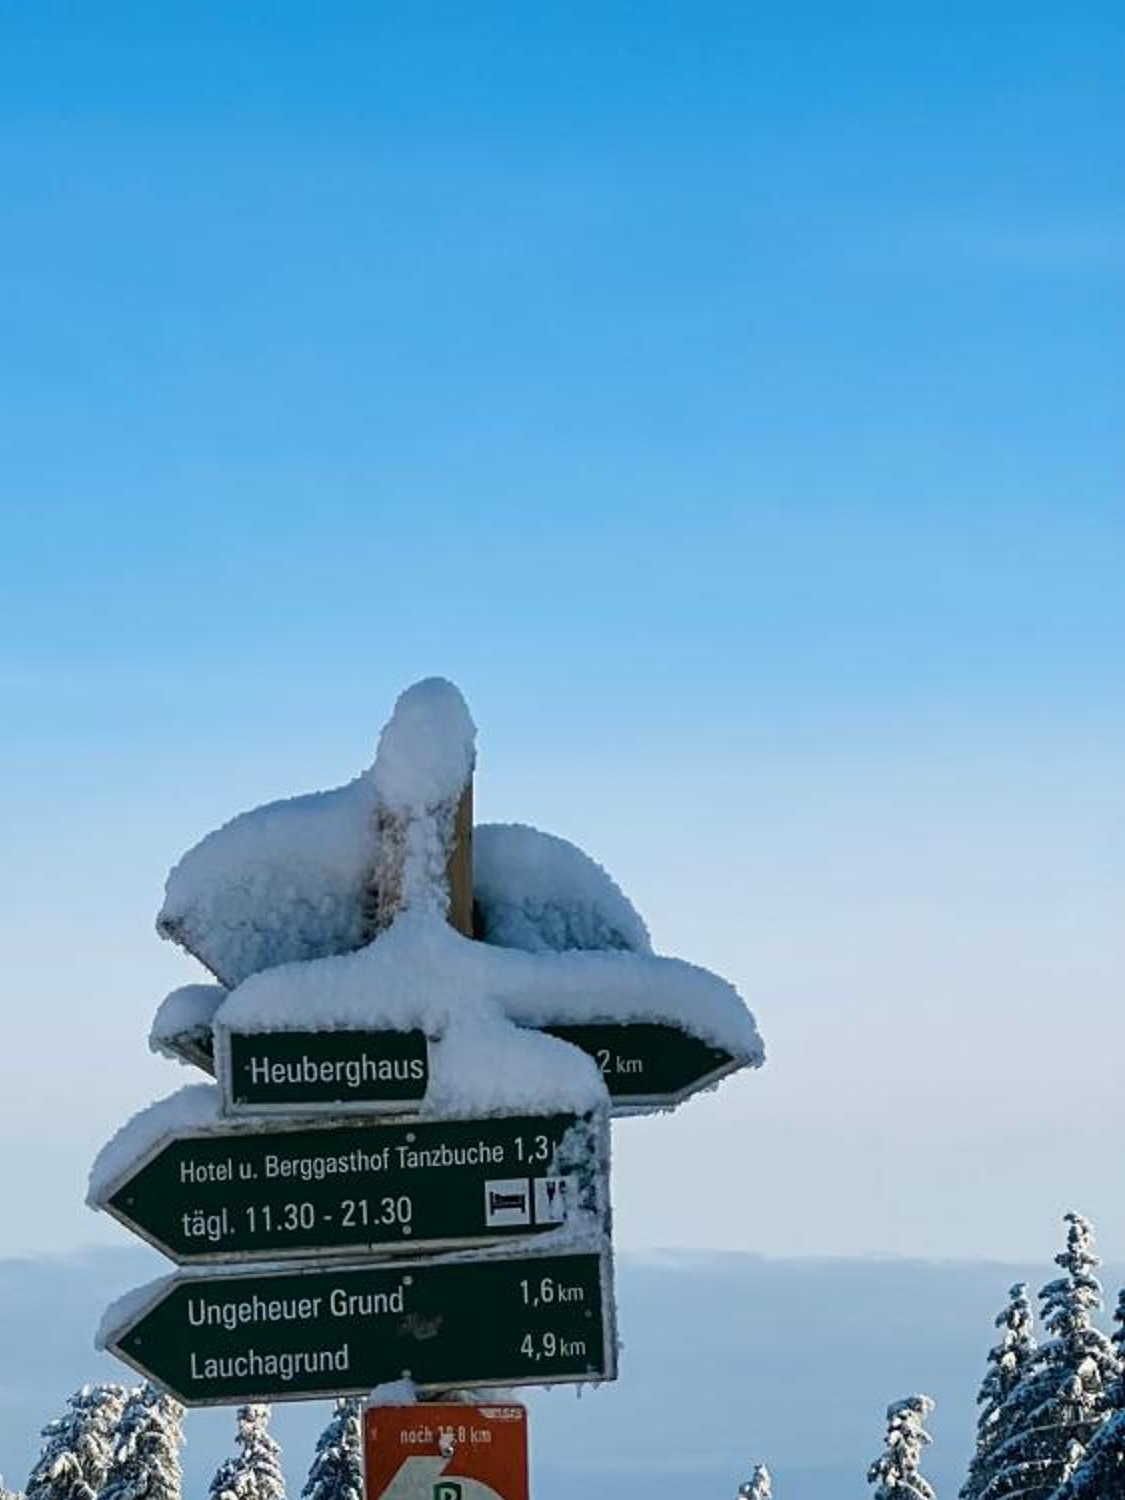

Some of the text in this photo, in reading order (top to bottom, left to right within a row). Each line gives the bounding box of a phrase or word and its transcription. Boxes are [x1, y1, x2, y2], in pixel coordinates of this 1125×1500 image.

[250, 1053, 425, 1088] Heuberghaus
[616, 1055, 644, 1074] km
[180, 1157, 233, 1184] Hotel
[239, 1161, 259, 1181] u.
[265, 1147, 390, 1182] Berggasthof
[395, 1140, 505, 1170] Tanzbuche
[514, 1134, 549, 1165] 1,3
[181, 1207, 237, 1242] tägl.
[246, 1202, 316, 1233] 11.30
[341, 1196, 413, 1228] 21.30
[188, 1277, 585, 1331] Ungeheuer Grund 1,6 km
[190, 1332, 587, 1381] Lauchagrund 4,9 km
[400, 1425, 433, 1444] noch
[470, 1425, 492, 1444] km
